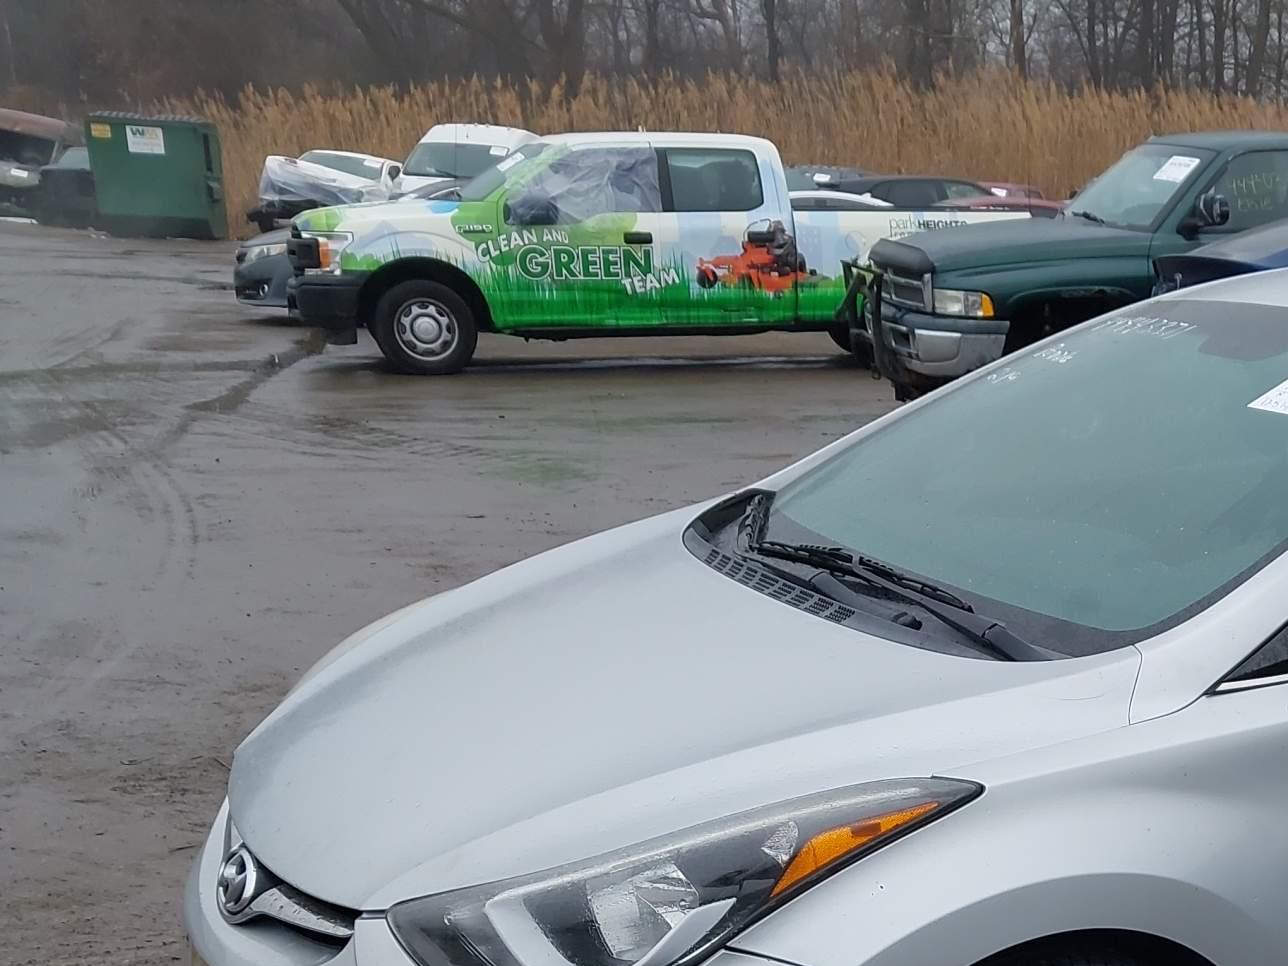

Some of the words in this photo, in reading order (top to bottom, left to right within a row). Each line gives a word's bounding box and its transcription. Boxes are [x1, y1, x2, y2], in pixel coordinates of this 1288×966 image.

[477, 228, 537, 263] CLEAN
[543, 228, 569, 244] AND
[516, 244, 654, 281] GREEN
[621, 267, 681, 296] TEAM
